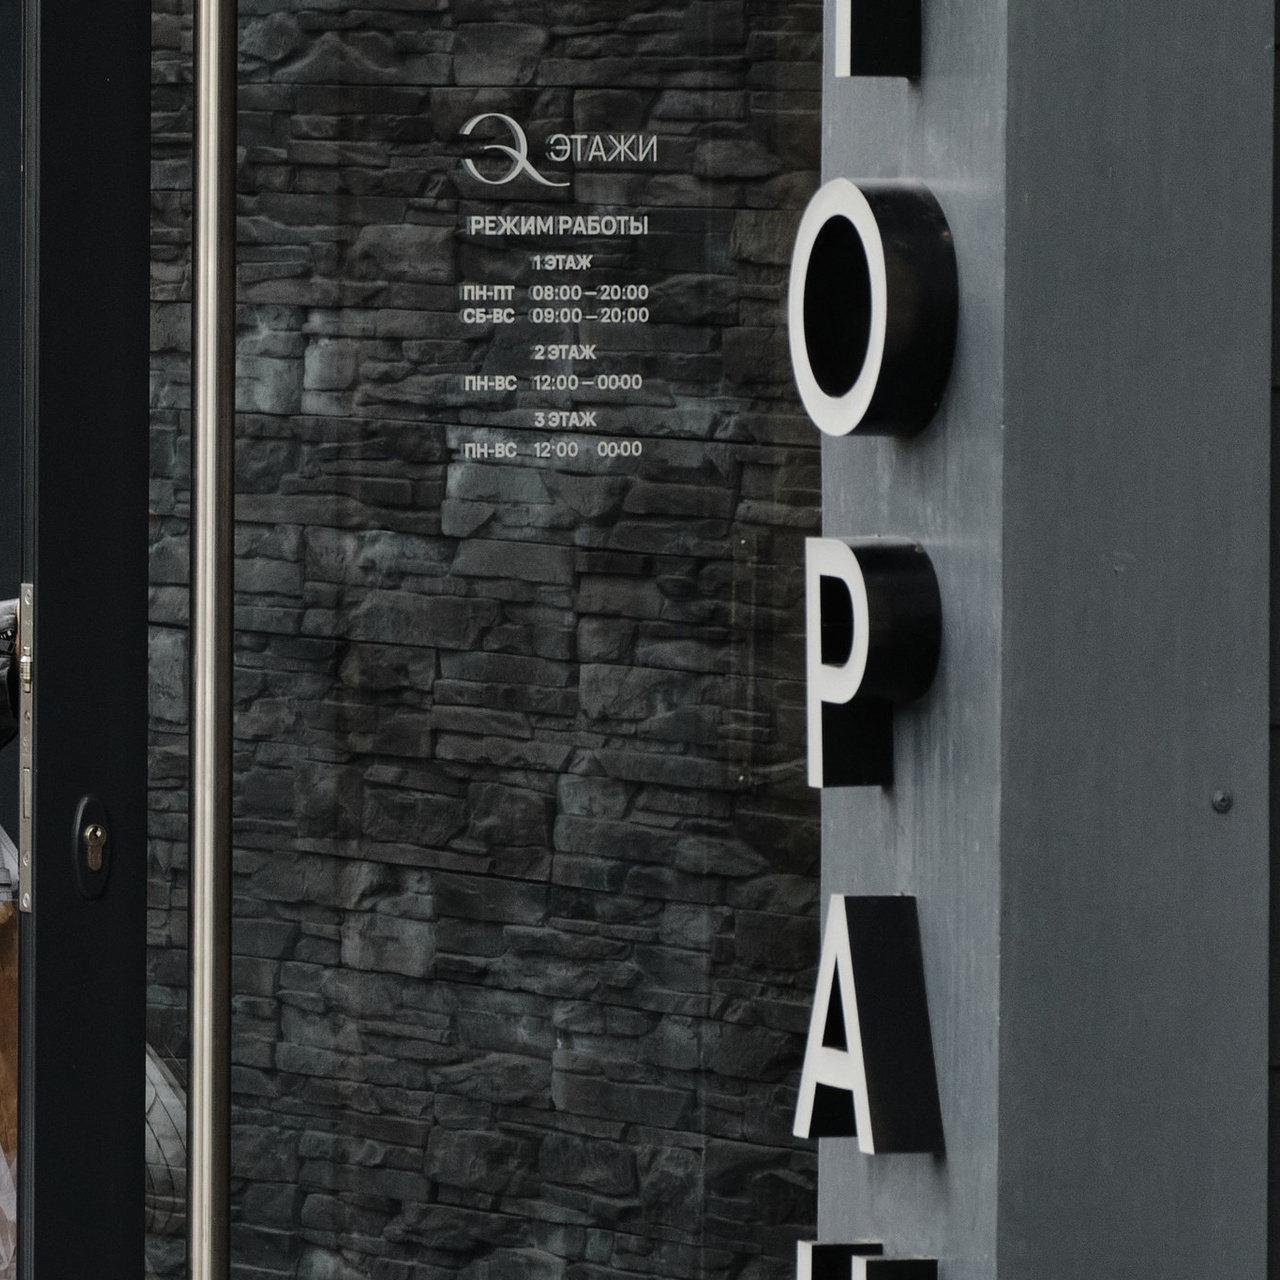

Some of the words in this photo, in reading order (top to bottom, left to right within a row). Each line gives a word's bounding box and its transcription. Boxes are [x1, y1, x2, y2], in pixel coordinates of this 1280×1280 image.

[548, 133, 658, 162] ЭТАЖИ
[470, 215, 554, 236] РЕЖИМ
[558, 215, 649, 236] РАБОТЫ
[533, 254, 541, 270] 1
[544, 254, 594, 270] ЭТАЖ
[463, 284, 516, 301] ПН-ПТ
[463, 307, 516, 324] СБ-ВС
[533, 344, 546, 360] 2
[547, 344, 597, 360] ЭТАЖ
[464, 375, 518, 391] ПН-ВС
[534, 411, 546, 427] 3
[547, 411, 597, 427] ЭТАЖ
[464, 441, 518, 458] ПН-ВС
